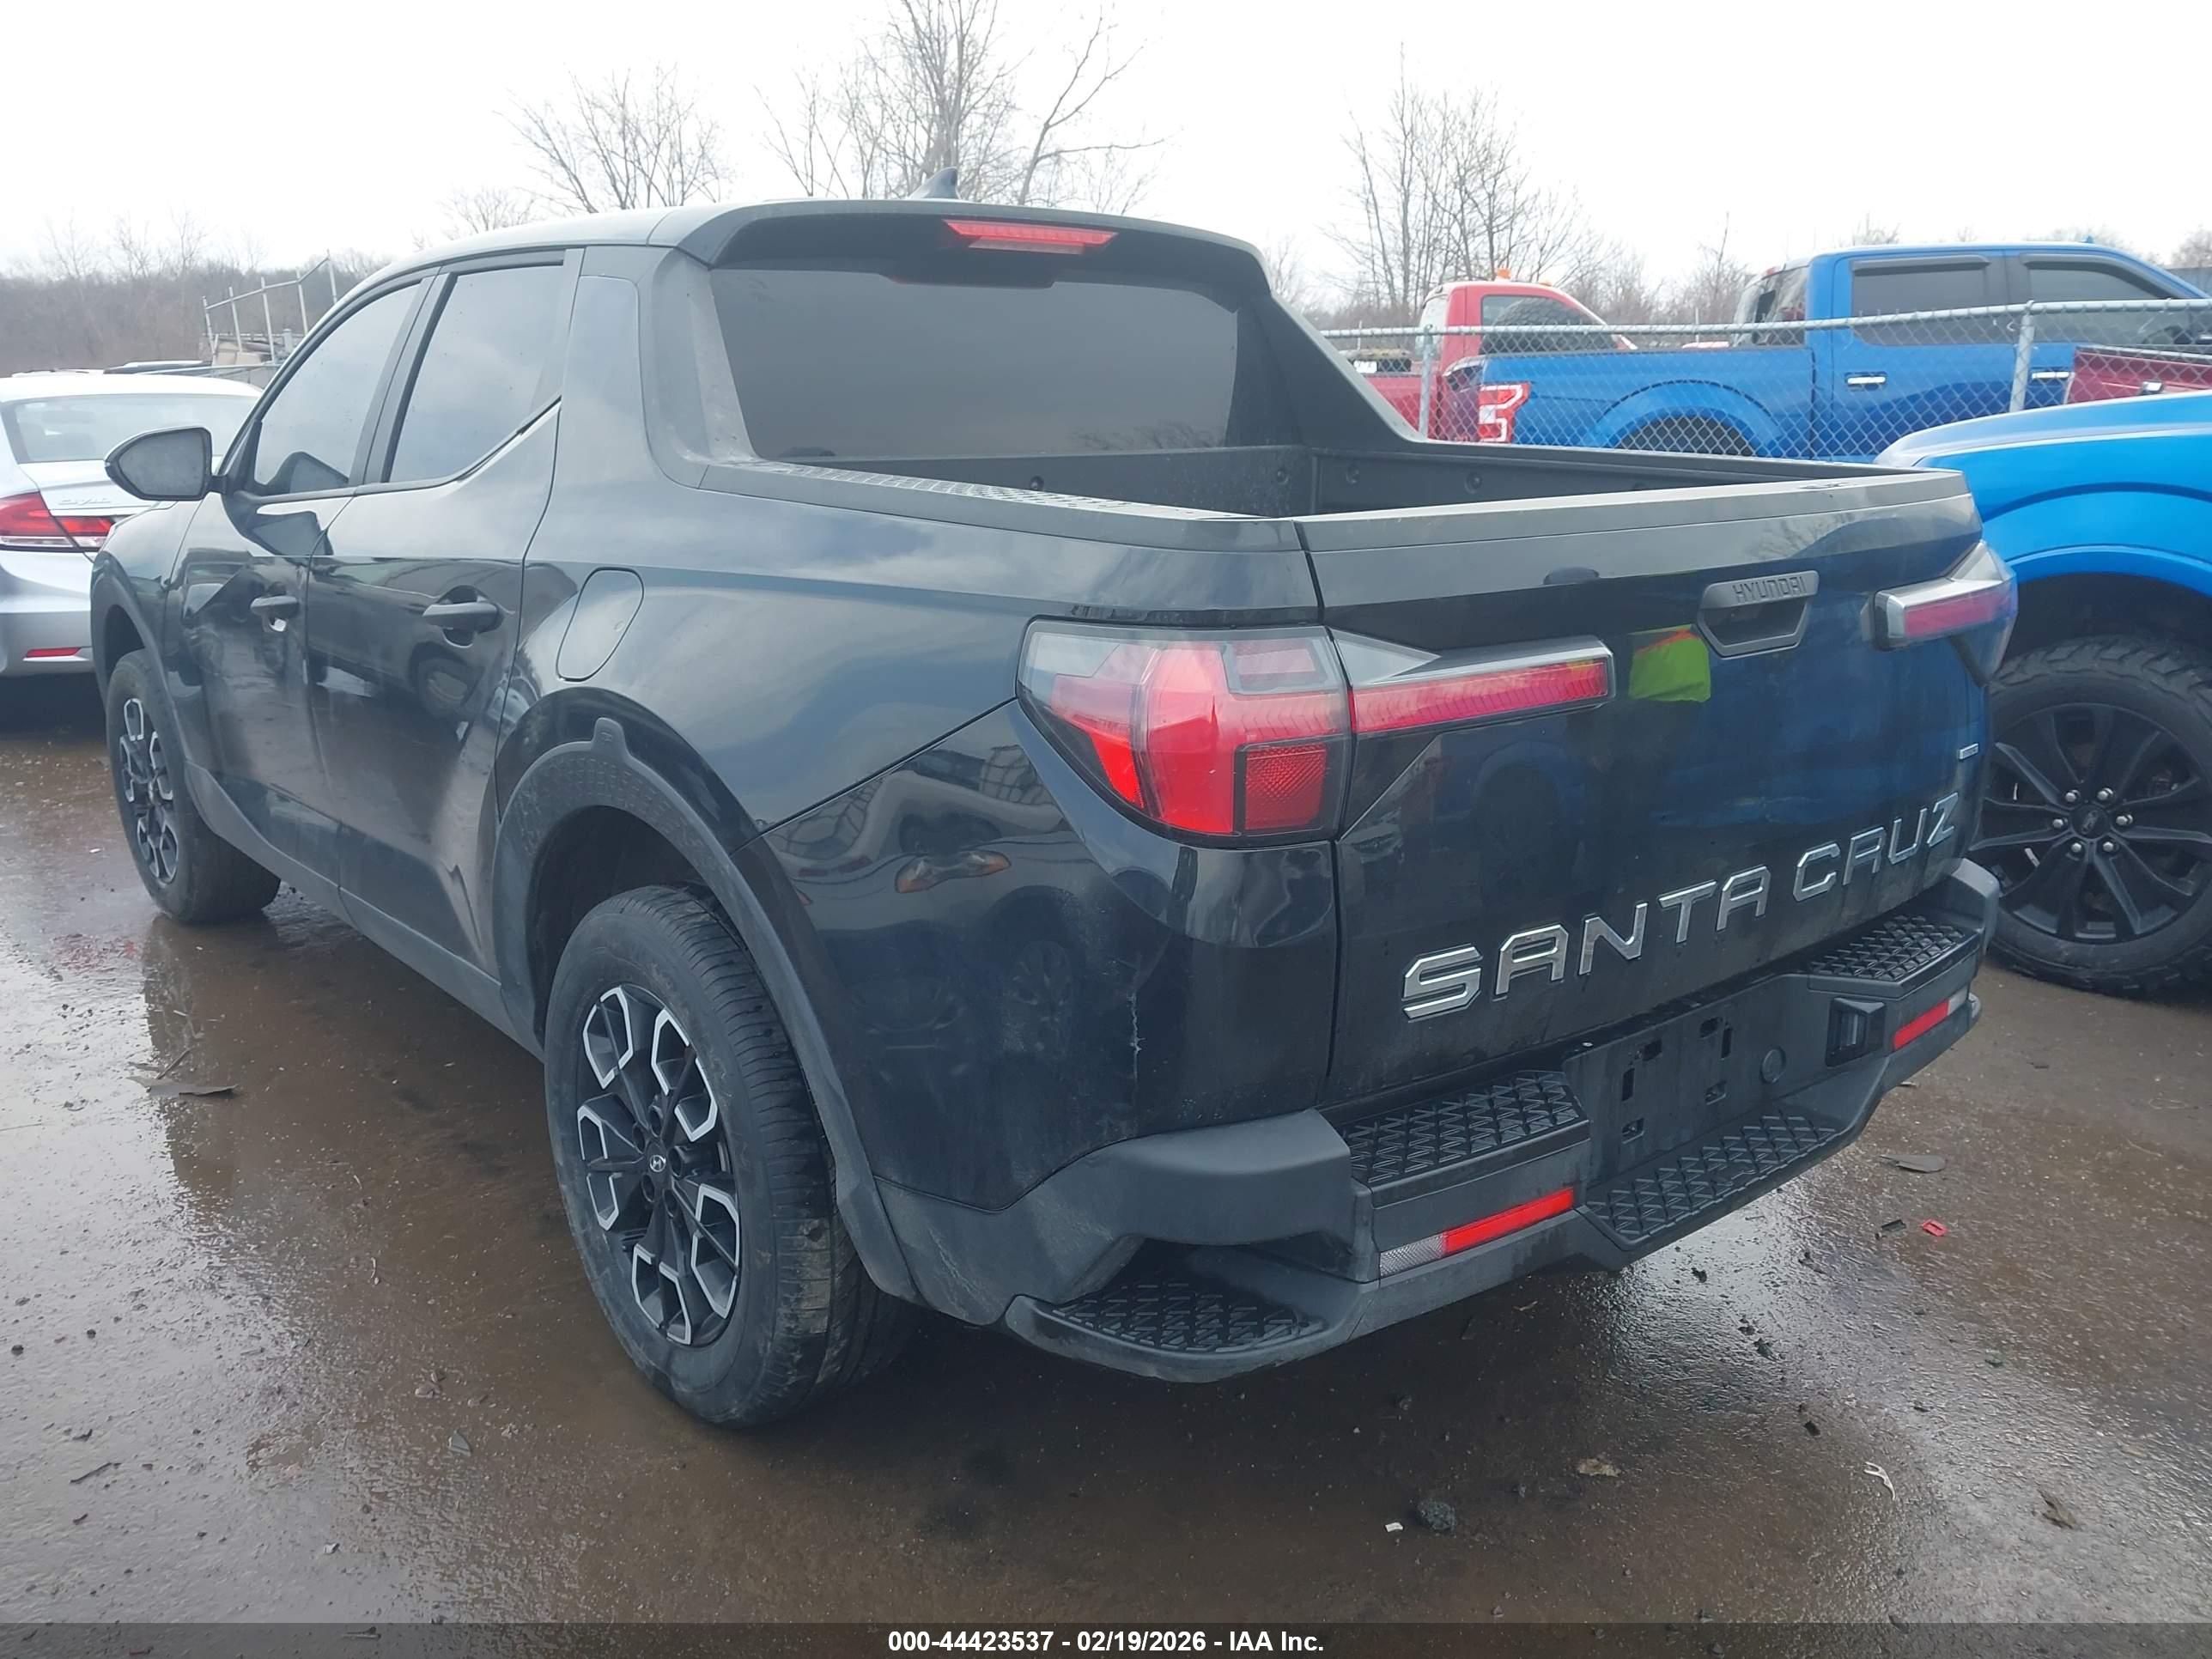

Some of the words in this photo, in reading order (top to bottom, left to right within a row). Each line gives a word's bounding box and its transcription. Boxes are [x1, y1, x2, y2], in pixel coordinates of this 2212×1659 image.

[1733, 576, 1807, 604] HYUNDAI
[1403, 865, 1771, 1020] SANTA
[1793, 793, 1960, 902] CRUZ
